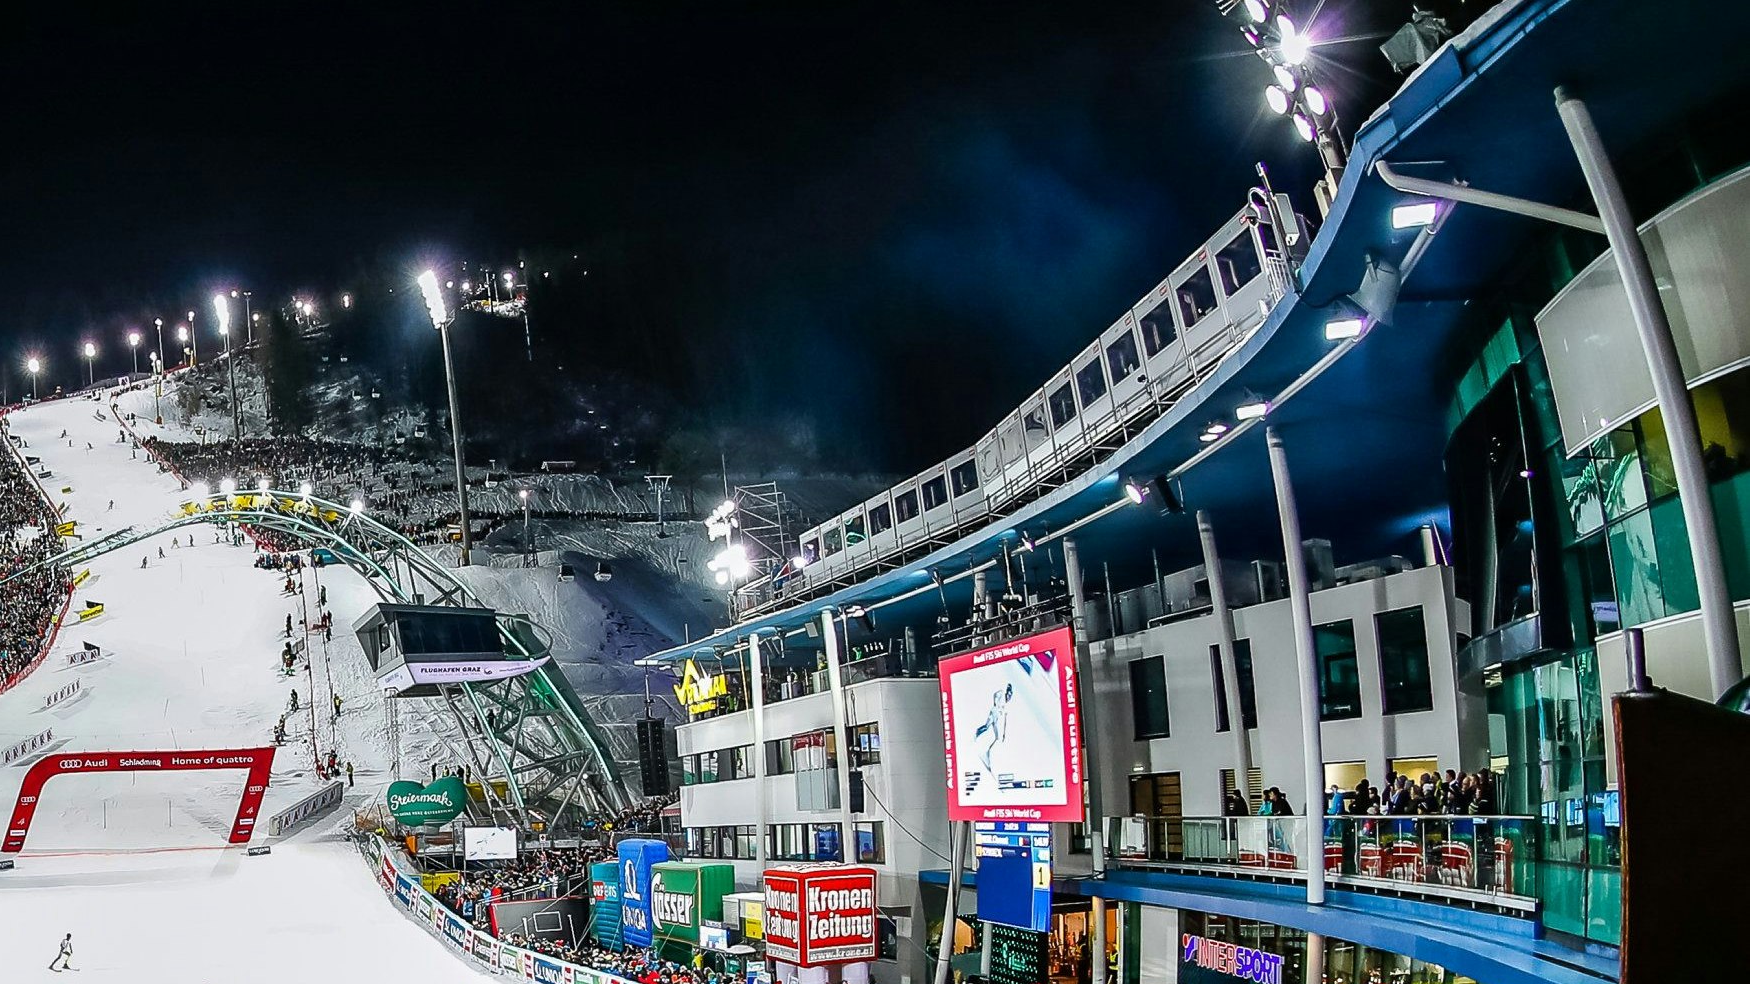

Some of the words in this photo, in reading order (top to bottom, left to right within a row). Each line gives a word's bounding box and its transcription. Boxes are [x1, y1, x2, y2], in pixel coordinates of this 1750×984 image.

[84, 759, 108, 767] Audi
[172, 757, 201, 765] Home
[204, 756, 215, 764] of
[216, 755, 254, 766] quattro
[390, 791, 453, 811] Steiermark
[1038, 867, 1044, 885] 1
[651, 873, 694, 932] Gösser
[765, 884, 797, 913] Kronen
[809, 887, 872, 912] Kronen
[766, 910, 799, 943] Zeitung
[810, 912, 872, 940] Zeitung
[810, 946, 873, 960] www.krone.at
